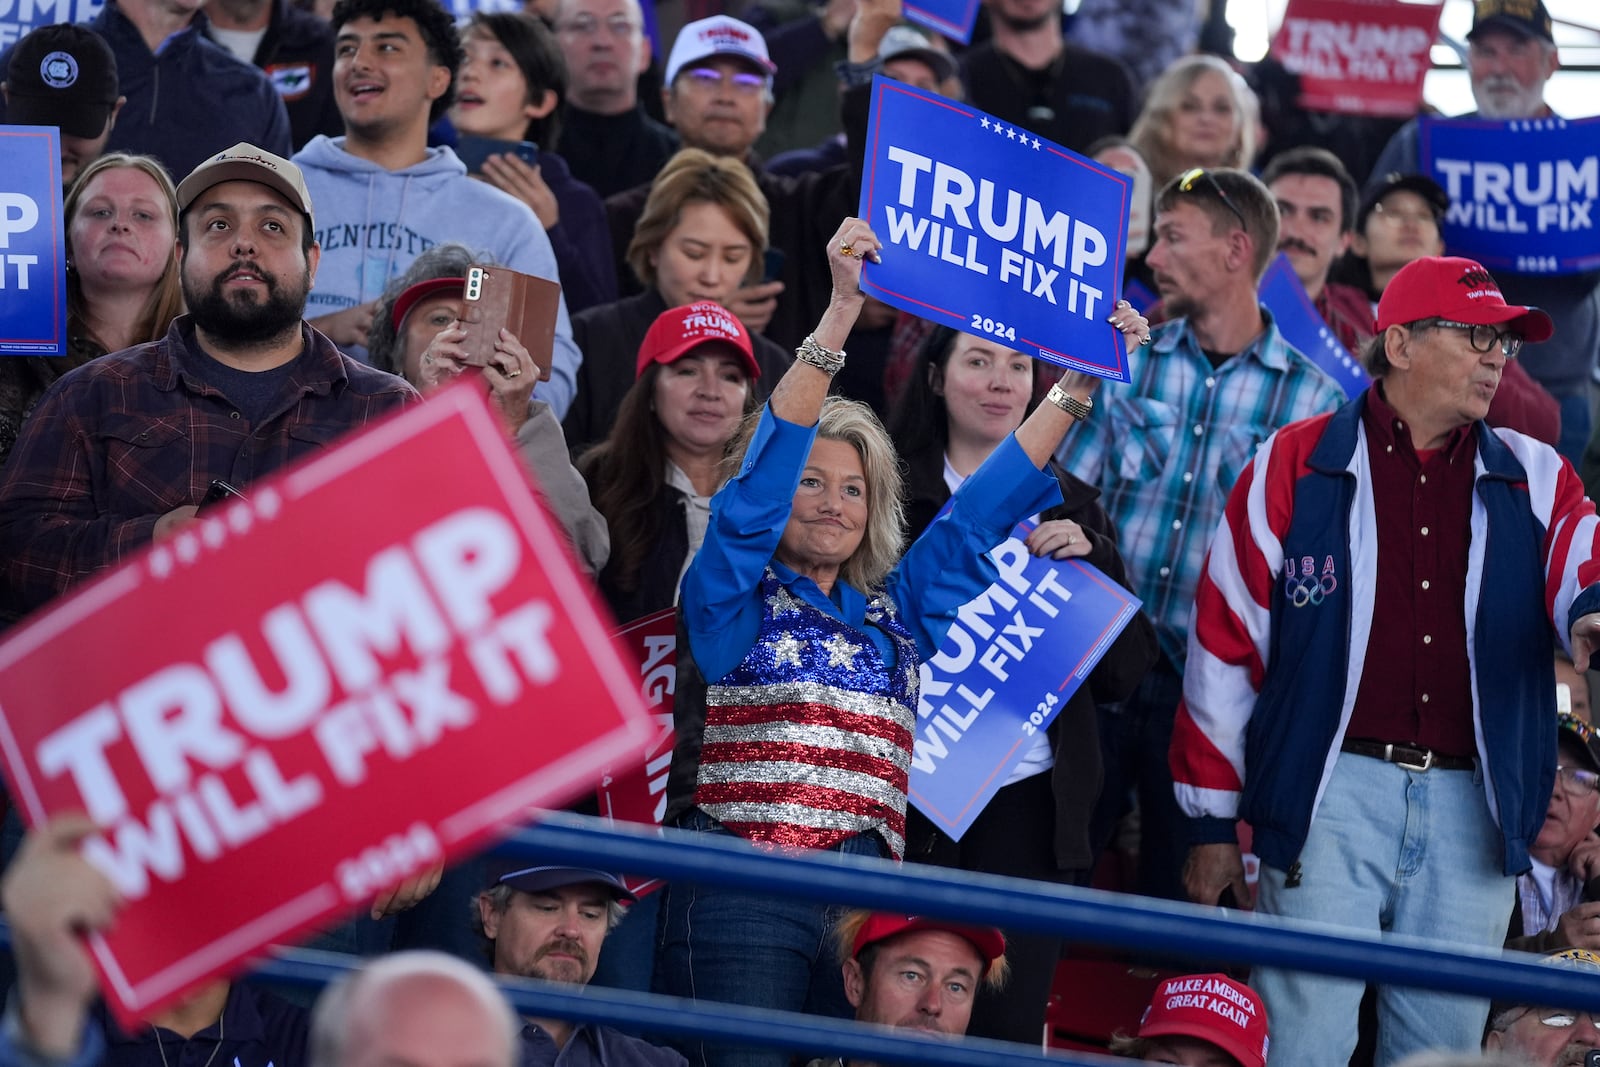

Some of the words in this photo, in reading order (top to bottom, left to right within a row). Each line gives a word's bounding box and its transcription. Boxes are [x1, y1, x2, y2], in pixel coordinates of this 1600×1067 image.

[1287, 17, 1430, 57] TRUMP
[1436, 155, 1599, 207] TRUM
[887, 145, 1108, 277] TRUMP
[1536, 200, 1593, 234] FIX
[885, 205, 988, 275] WILL
[1000, 247, 1060, 305] FIX
[1067, 278, 1103, 321] IT
[682, 315, 739, 337] TRUMP
[970, 313, 1017, 343] 2024
[35, 507, 521, 830] TRUMP
[910, 687, 996, 775] WILL
[978, 610, 1045, 683] FIX
[1028, 567, 1073, 619] IT
[1021, 691, 1060, 737] 2024
[80, 748, 322, 900] WILL
[313, 658, 478, 787] FIX
[468, 599, 560, 706] IT
[1163, 979, 1203, 996] MAKE
[1204, 979, 1256, 1016] AMERICA
[1165, 993, 1209, 1011] GREAT
[1208, 1000, 1249, 1029] AGAIN
